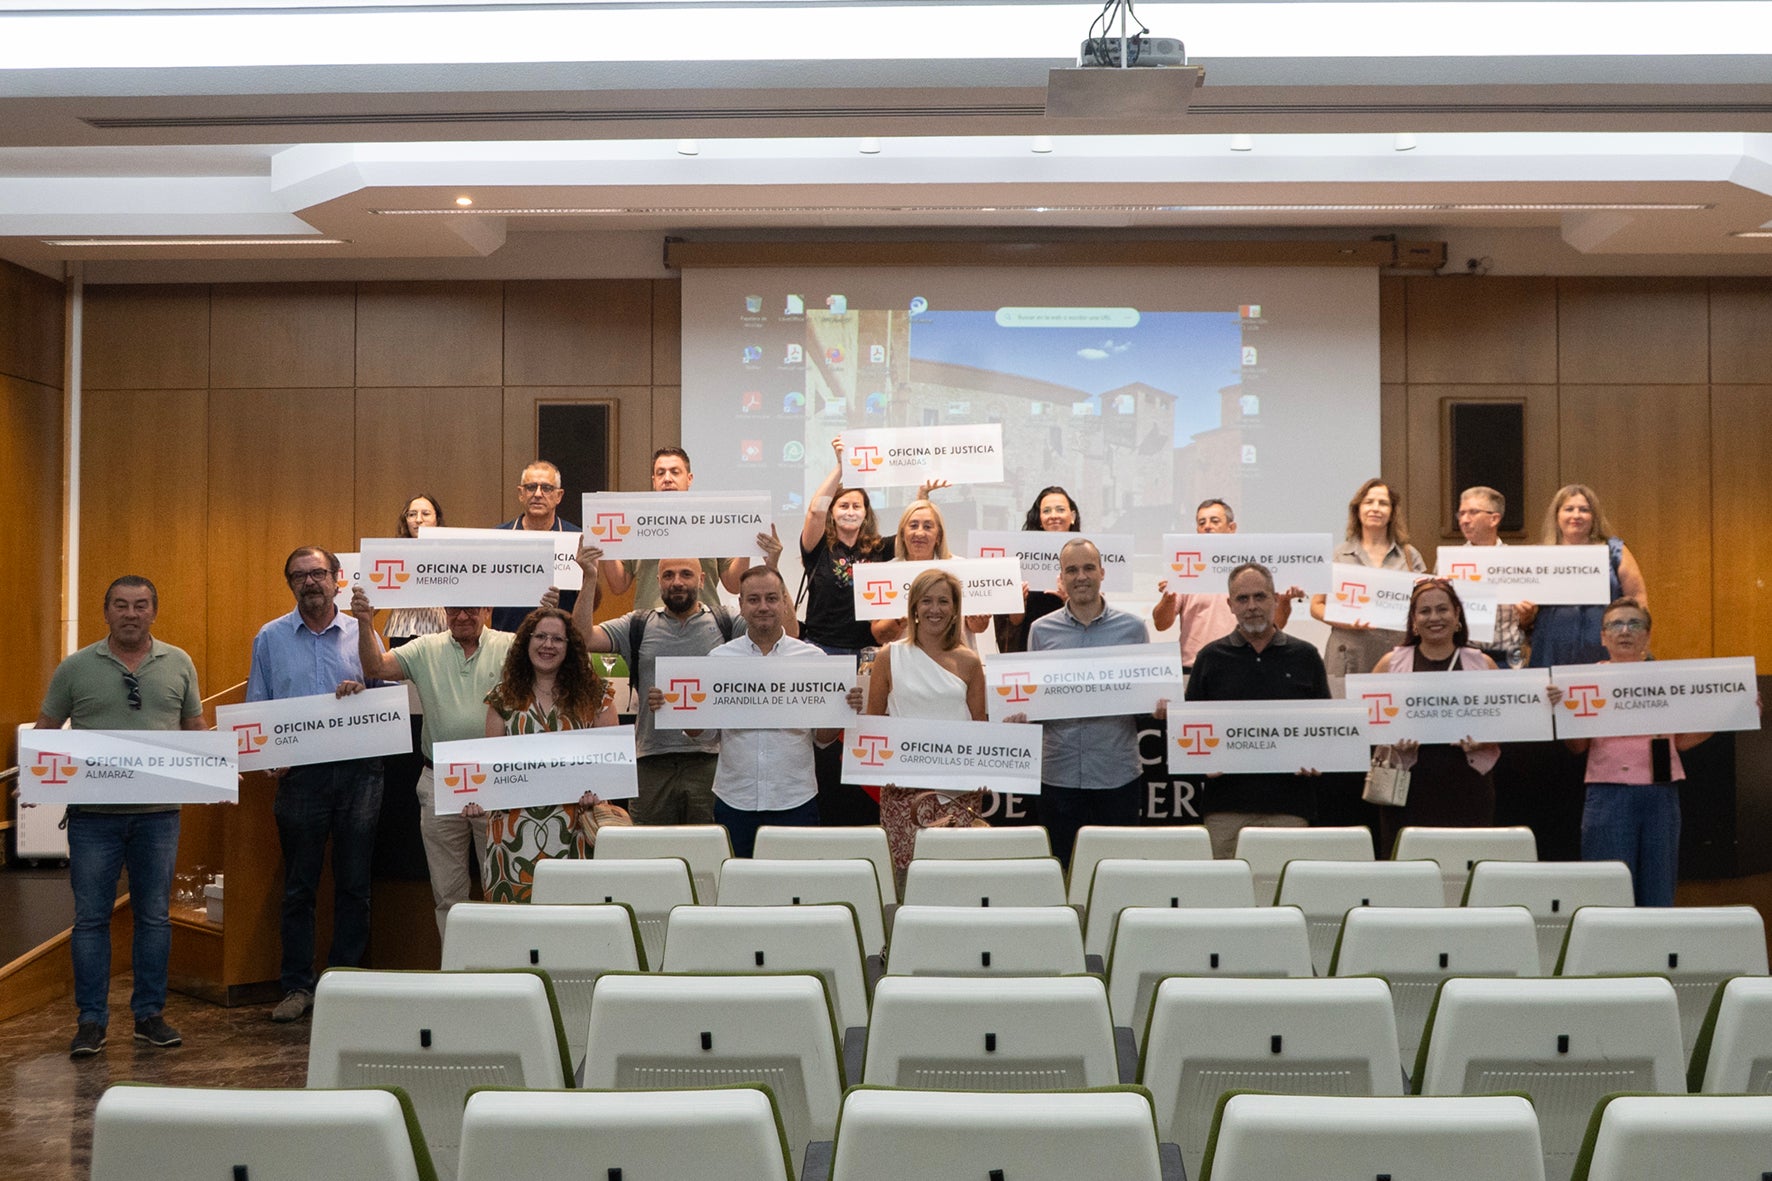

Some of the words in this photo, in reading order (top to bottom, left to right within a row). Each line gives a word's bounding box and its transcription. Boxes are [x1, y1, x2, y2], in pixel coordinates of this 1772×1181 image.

[889, 448, 931, 457] OFICINA
[935, 447, 947, 455] DE
[950, 445, 994, 454] JUSTICIA
[889, 458, 926, 466] MIAJADAS
[637, 515, 687, 525] OFICINA
[691, 515, 705, 524] DE
[710, 514, 762, 524] JUSTICIA
[637, 528, 669, 537] HOYOS
[554, 553, 576, 561] ICIA
[1212, 555, 1257, 564] OFICINA
[1260, 555, 1273, 563] DE
[1277, 555, 1324, 563] JUSTICIA
[417, 564, 468, 573] OFICINA
[472, 564, 487, 573] DE
[491, 564, 544, 573] JUSTICIA
[1042, 563, 1052, 571] DE
[1487, 566, 1532, 575] OFICINA
[1536, 566, 1549, 575] DE
[1553, 566, 1600, 575] JUSTICIA
[416, 575, 459, 585] MEMBRÍO
[967, 579, 1014, 588] JUSTICIA
[968, 590, 992, 598] VALLE
[1377, 591, 1411, 601] OFICIN
[1044, 672, 1095, 683] OFICINA
[1100, 670, 1114, 680] DE
[1118, 666, 1173, 678] JUSTICIA
[713, 683, 766, 693] OFICINA
[770, 682, 786, 692] DE
[790, 682, 846, 692] JUSTICIA
[1045, 685, 1083, 695] ARROYO
[1086, 684, 1097, 692] DE
[1100, 684, 1112, 692] LA
[1114, 683, 1132, 691] LUZ
[1612, 686, 1666, 698] OFICINA
[1670, 685, 1685, 695] DE
[1691, 682, 1746, 694] JUSTICIA
[712, 696, 769, 705] JARANDILLA
[771, 696, 783, 705] DE
[801, 696, 826, 704] VERA
[1405, 696, 1459, 707] OFICINA
[1464, 695, 1479, 705] DE
[1484, 694, 1540, 705] JUSTICIA
[1406, 709, 1438, 719] CASAR
[1442, 709, 1453, 718] DE
[274, 720, 324, 734] OFICINA
[329, 717, 343, 728] DE
[347, 711, 400, 726] JUSTICIA
[1226, 728, 1280, 738] OFICINA
[1284, 727, 1299, 737] DE
[1303, 726, 1359, 737] JUSTICIA
[275, 736, 299, 745] GATA
[1226, 741, 1277, 750] MORALEJA
[901, 741, 953, 754] OFICINA
[958, 745, 972, 755] DE
[976, 746, 1031, 758] JUSTICIA
[85, 757, 143, 767] OFICINA
[148, 757, 164, 767] DE
[169, 756, 228, 767] JUSTICIA
[492, 760, 546, 773] OFICINA
[551, 757, 566, 768] DE
[569, 752, 626, 766] JUSTICIA
[900, 754, 961, 766] GARROVILLAS
[964, 758, 975, 767] DE
[85, 770, 134, 779] ALMARAZ
[493, 774, 528, 784] AHIGAL
